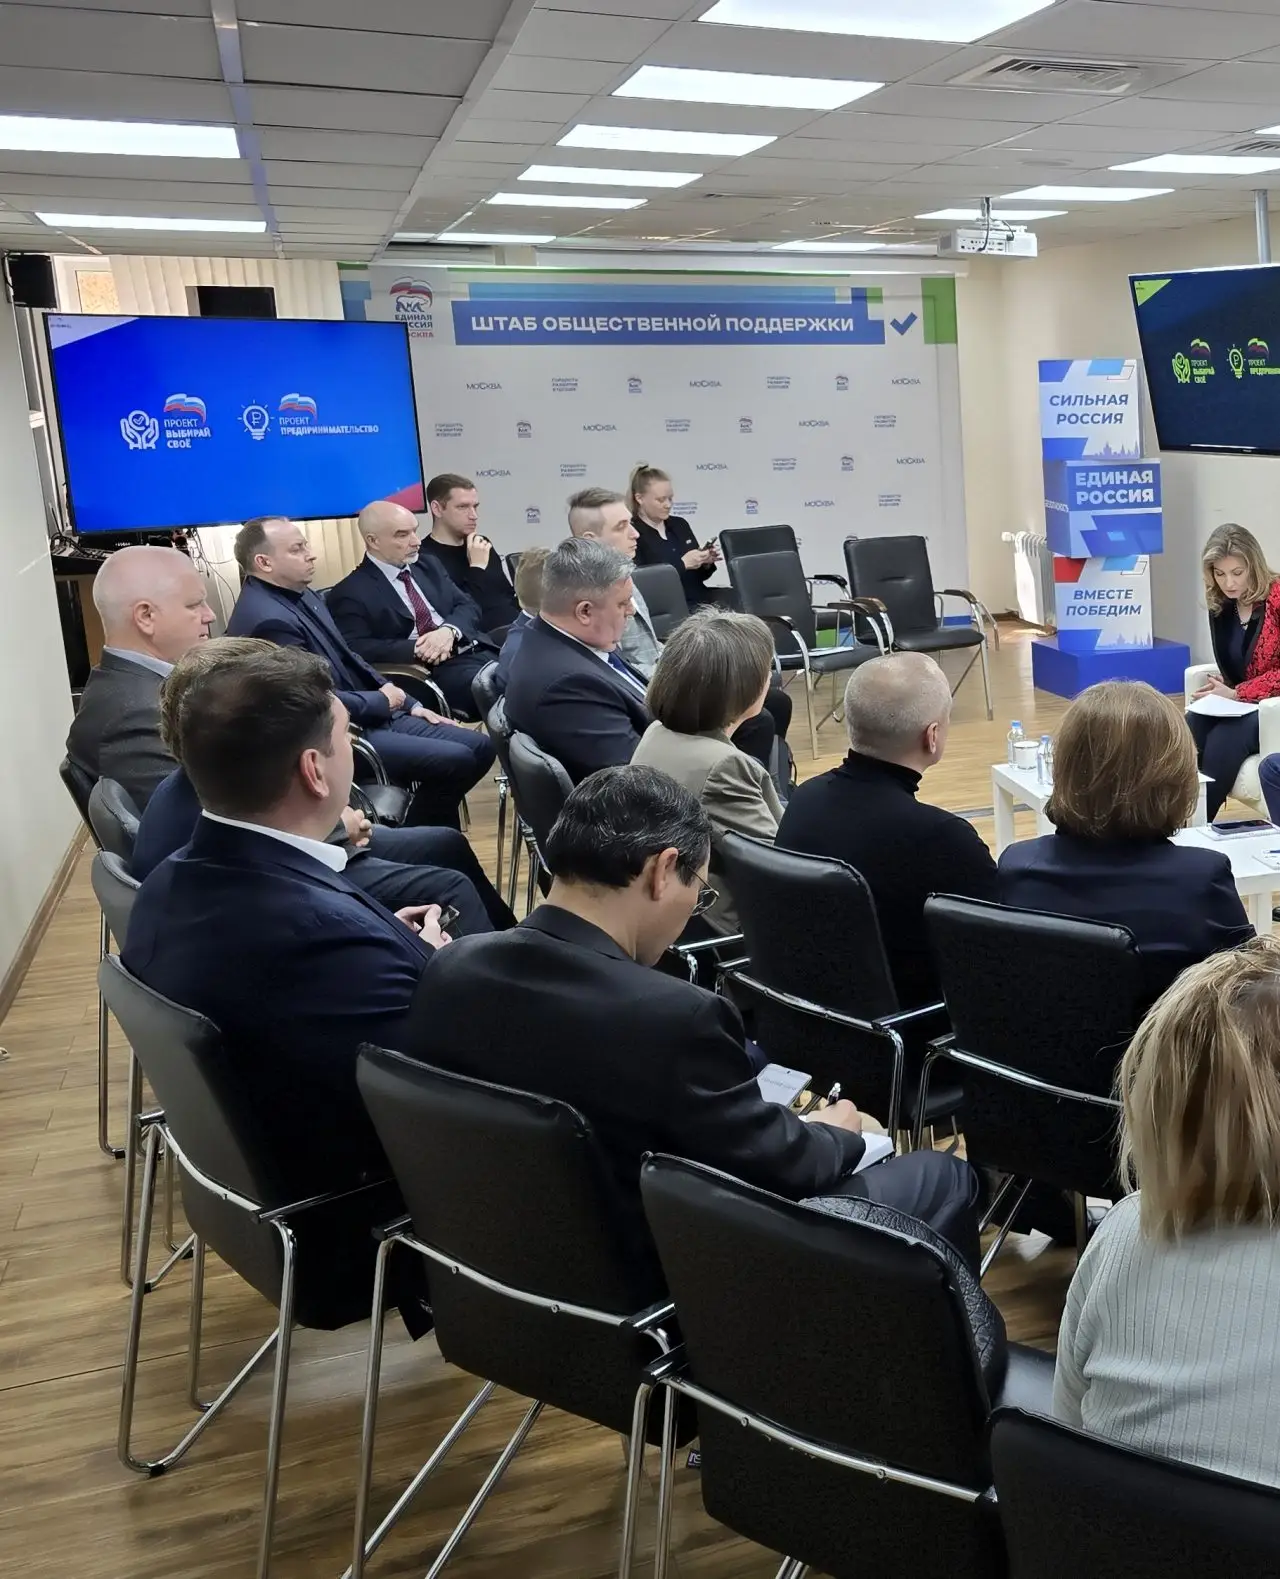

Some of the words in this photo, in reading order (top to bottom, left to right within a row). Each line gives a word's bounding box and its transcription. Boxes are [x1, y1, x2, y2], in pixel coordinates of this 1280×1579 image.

[471, 316, 537, 331] ШТАБ
[542, 314, 721, 333] ОБЩЕСТВЕННОЙ
[725, 317, 854, 334] ПОДДЕРЖКИ
[1049, 393, 1129, 407] СИЛЬНАЯ
[163, 418, 199, 429] ПРОЕКТ
[278, 416, 310, 426] ПРОЕКТ
[1056, 412, 1124, 425] РОССИЯ
[165, 427, 212, 439] ВЫБИРАЙ
[280, 424, 379, 436] ПРЕДПРИНИМАТЕЛЬСТВО
[166, 438, 192, 449] СВОЁ
[1075, 469, 1153, 488] ЕДИНАЯ
[1076, 488, 1154, 505] РОССИЯ
[1073, 588, 1134, 600] ВМЕСТЕ
[1065, 604, 1142, 617] ПОБЕДИМ
